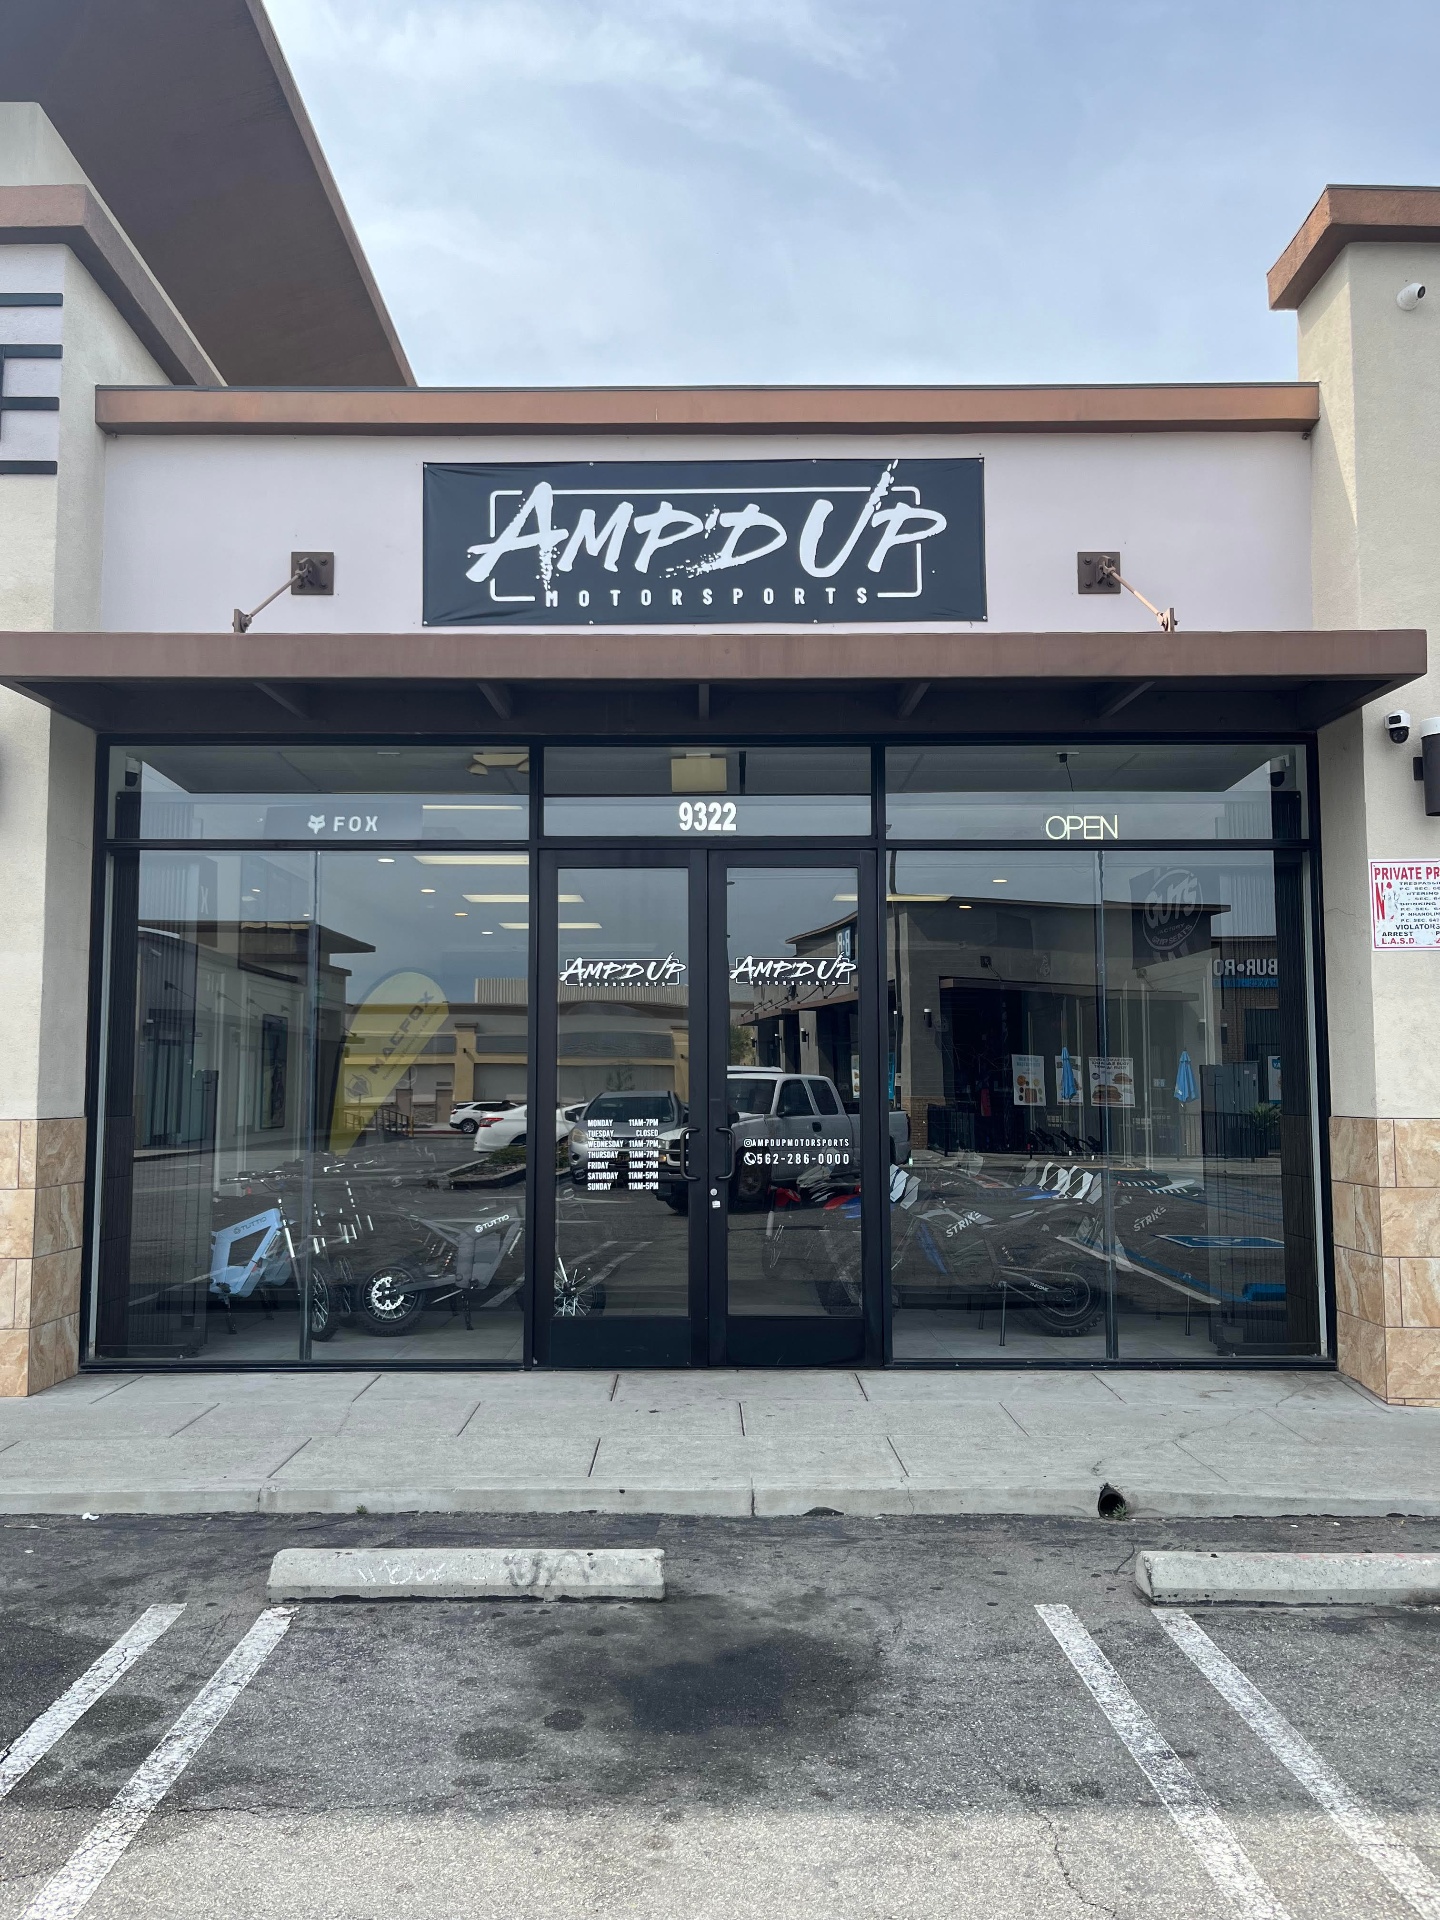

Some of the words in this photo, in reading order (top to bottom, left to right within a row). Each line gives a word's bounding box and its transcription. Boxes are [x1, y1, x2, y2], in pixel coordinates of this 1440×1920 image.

[799, 458, 948, 578] UP
[545, 587, 869, 608] MOTORSPORTS
[678, 801, 738, 832] 9322
[333, 815, 379, 832] FOX
[1045, 815, 1119, 840] OPEN
[1374, 867, 1422, 881] PRIVATE
[647, 951, 687, 981] UP
[817, 951, 857, 980] UP
[587, 1119, 614, 1127] MONDAY
[628, 1118, 659, 1127] 11AM-7PM
[587, 1129, 614, 1138] TUESDAY
[635, 1129, 659, 1137] CLOSED
[587, 1140, 624, 1148] WEDNESDAY
[628, 1140, 659, 1148] 11AM-7PM
[587, 1150, 619, 1159] THURSDAY
[628, 1150, 659, 1158] 11AM-7PM
[756, 1153, 850, 1165] 562-286-0000
[587, 1161, 609, 1170] FRIDAY
[628, 1161, 659, 1169] 11AM-7PM
[587, 1172, 619, 1180] SATURDAY
[627, 1171, 659, 1180] 11AM-5PM
[587, 1182, 612, 1191] SUNDAY
[628, 1182, 659, 1190] 11AM-5PM
